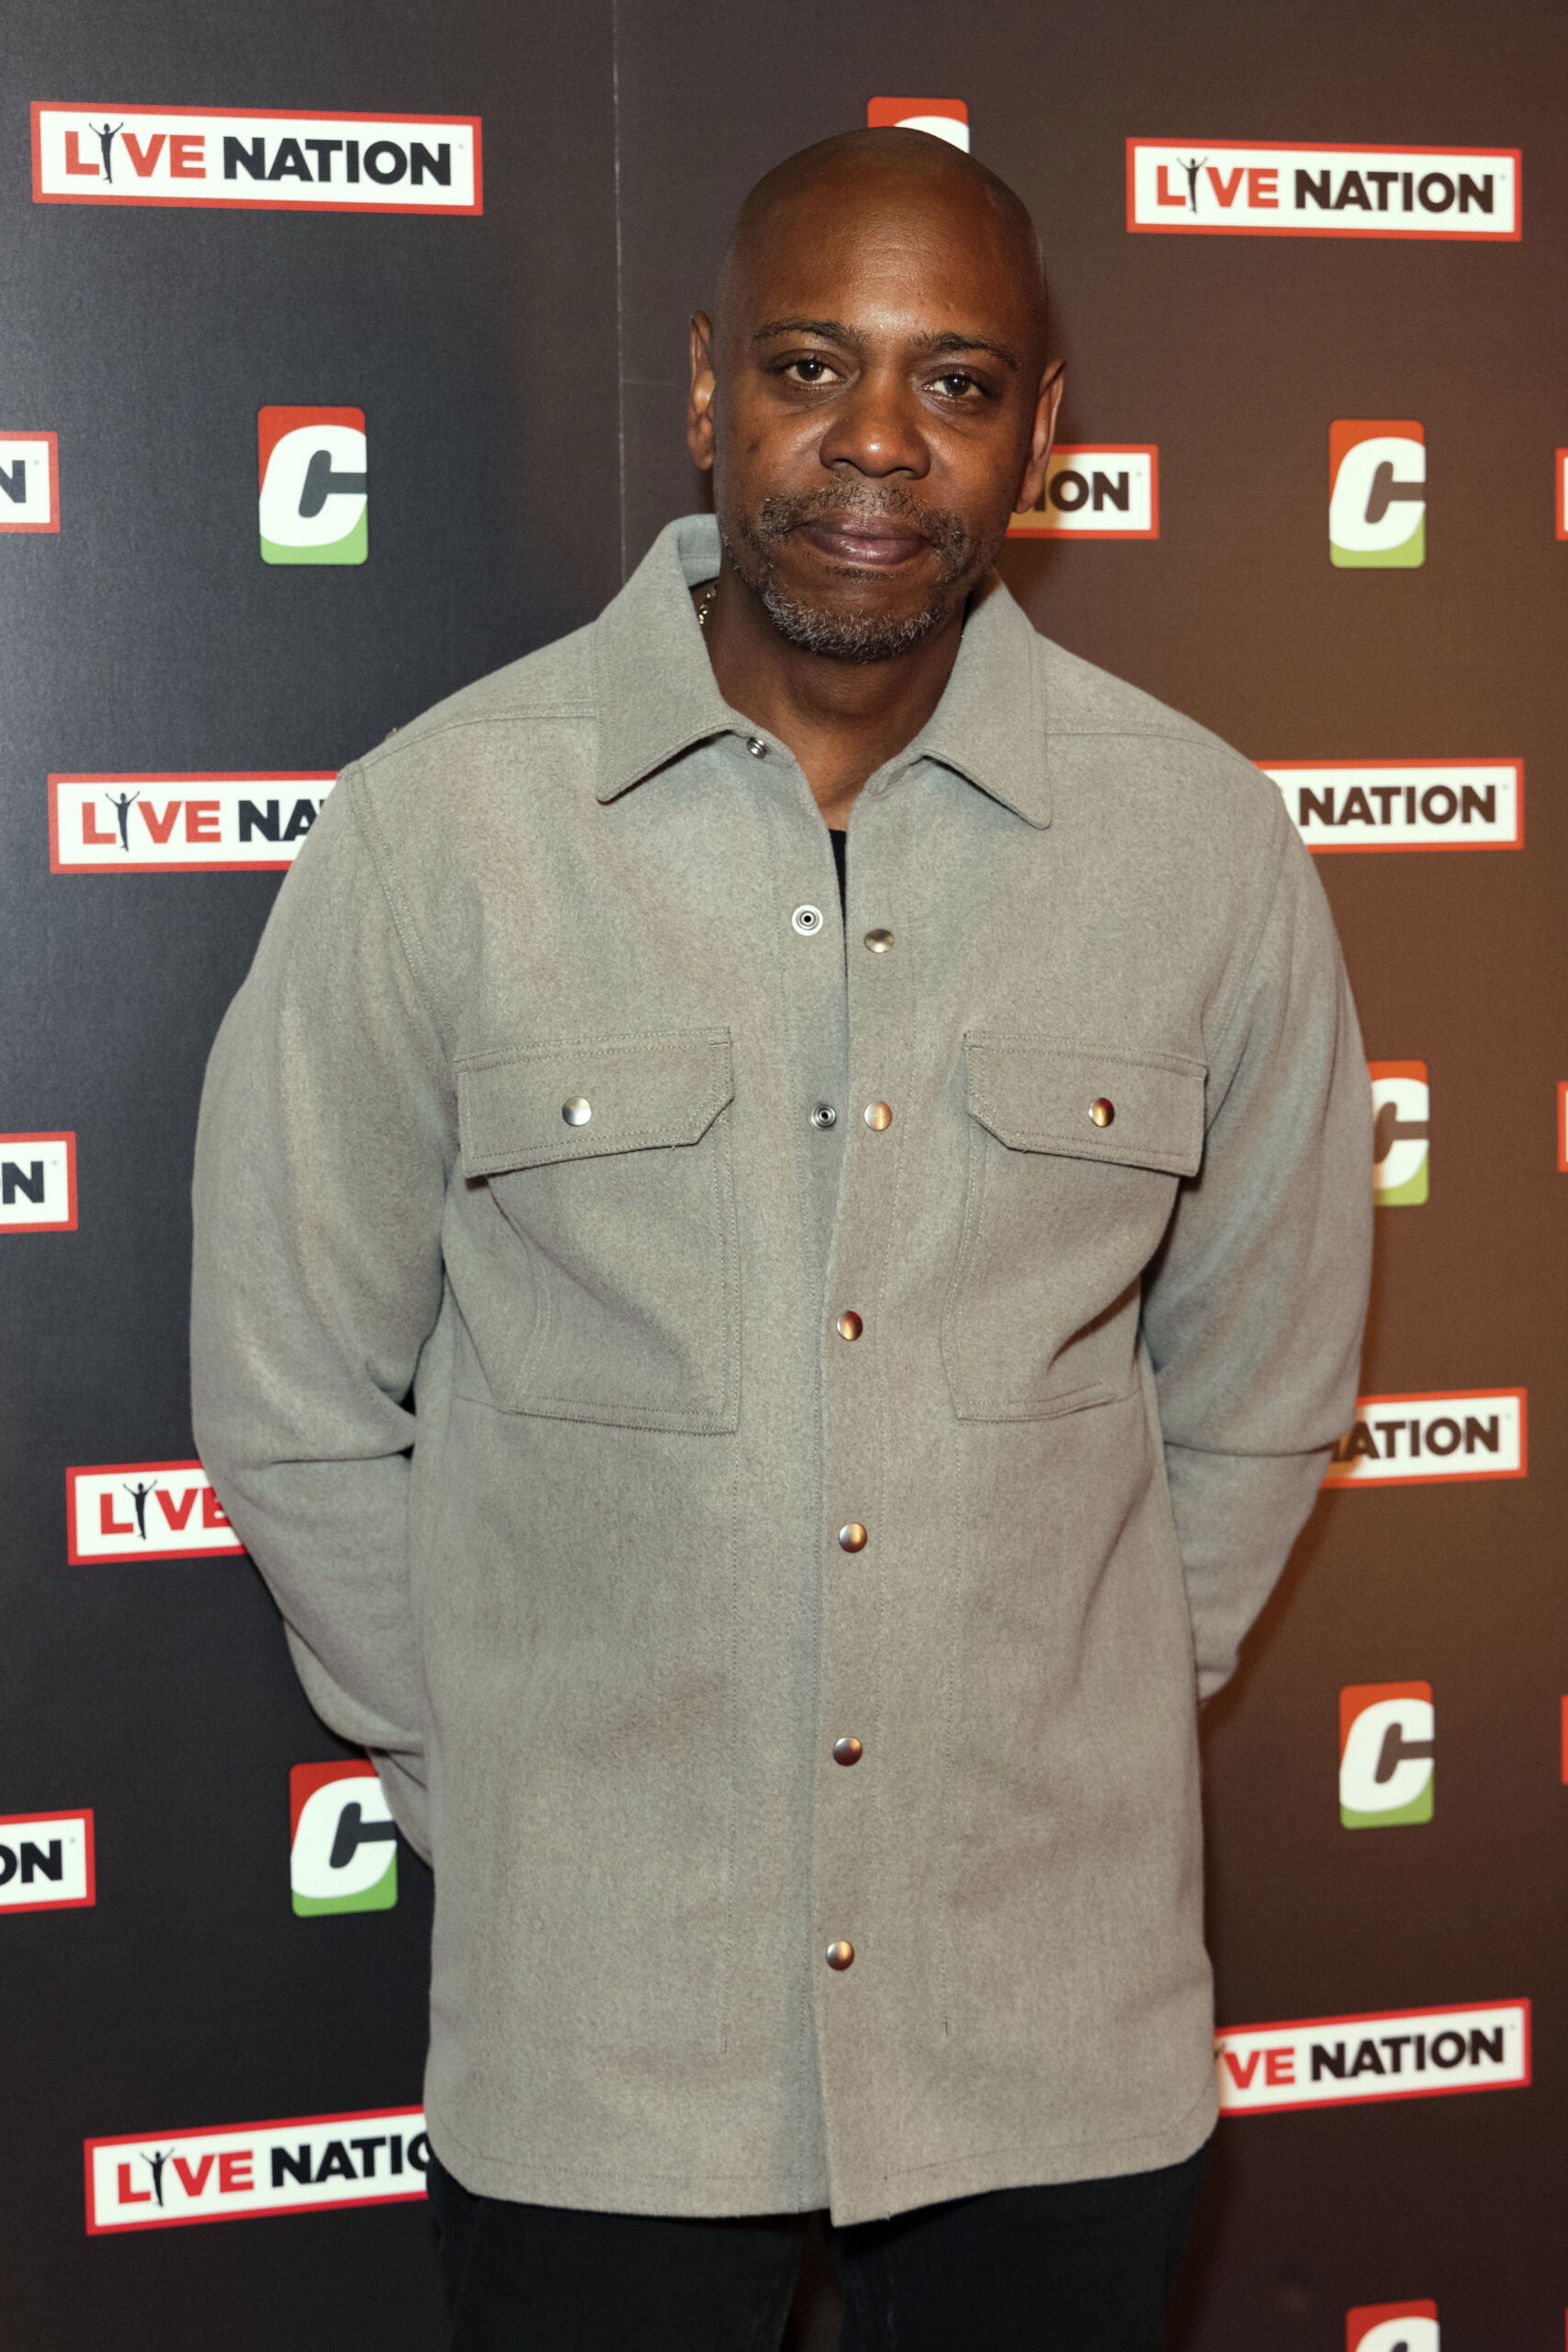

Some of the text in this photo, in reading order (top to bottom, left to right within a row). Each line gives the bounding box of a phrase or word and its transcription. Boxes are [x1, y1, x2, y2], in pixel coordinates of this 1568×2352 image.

[65, 122, 452, 187] LIVE NATION
[1156, 157, 1495, 214] LIVE NATION
[259, 424, 367, 548] C
[1330, 436, 1426, 551] C
[82, 791, 325, 852] LIVE NA
[1299, 785, 1495, 826] NATION
[1332, 1414, 1499, 1462] ATION
[1340, 1698, 1433, 1814] C
[1311, 2027, 1504, 2082] NATION
[118, 2149, 254, 2208] LIVE
